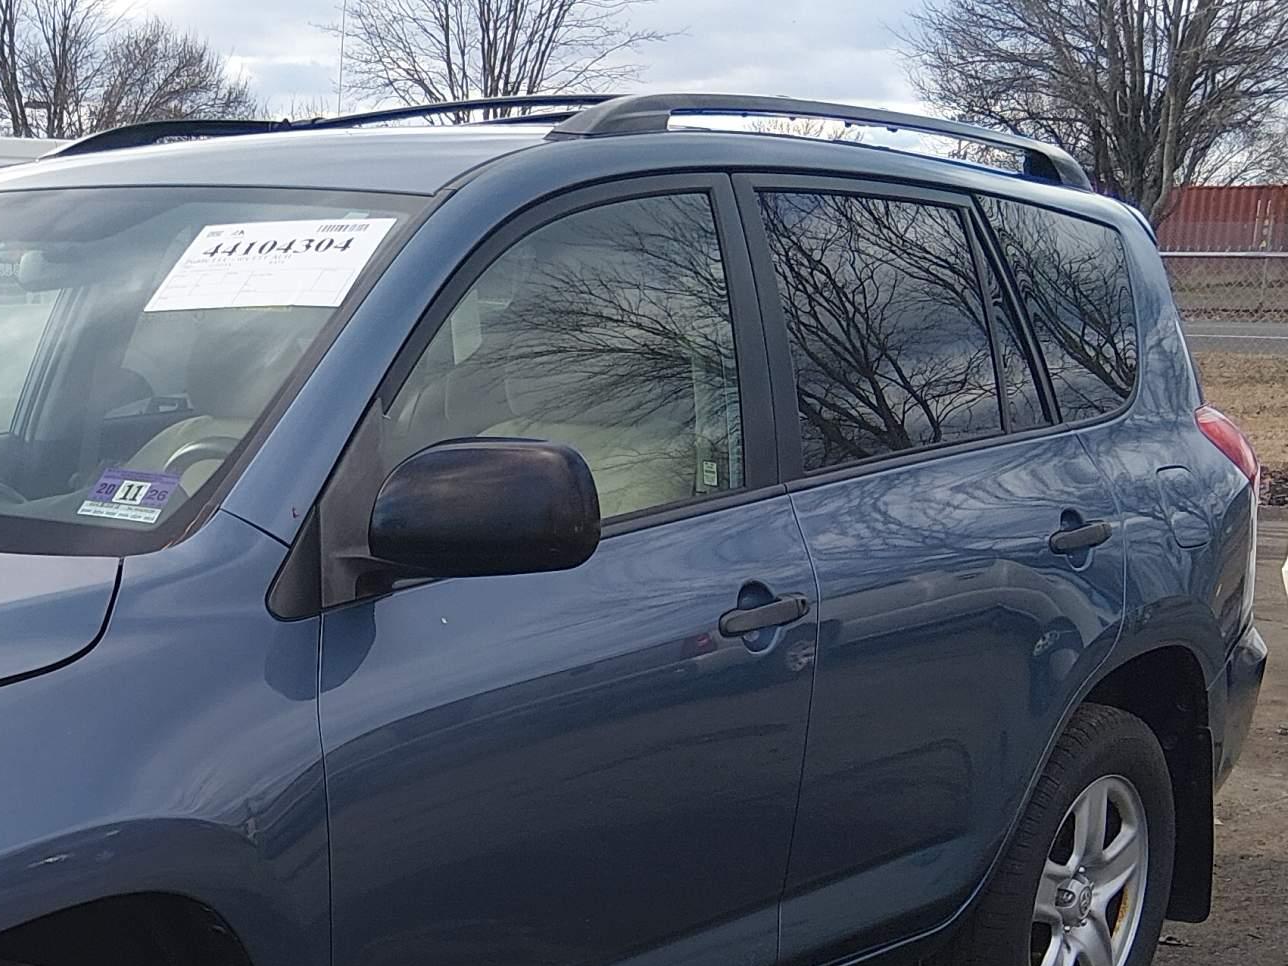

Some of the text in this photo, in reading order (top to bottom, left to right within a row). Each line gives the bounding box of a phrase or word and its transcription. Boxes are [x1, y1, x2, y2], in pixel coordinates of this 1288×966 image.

[203, 237, 354, 257] 44104304
[96, 482, 169, 502] 20 11 26
